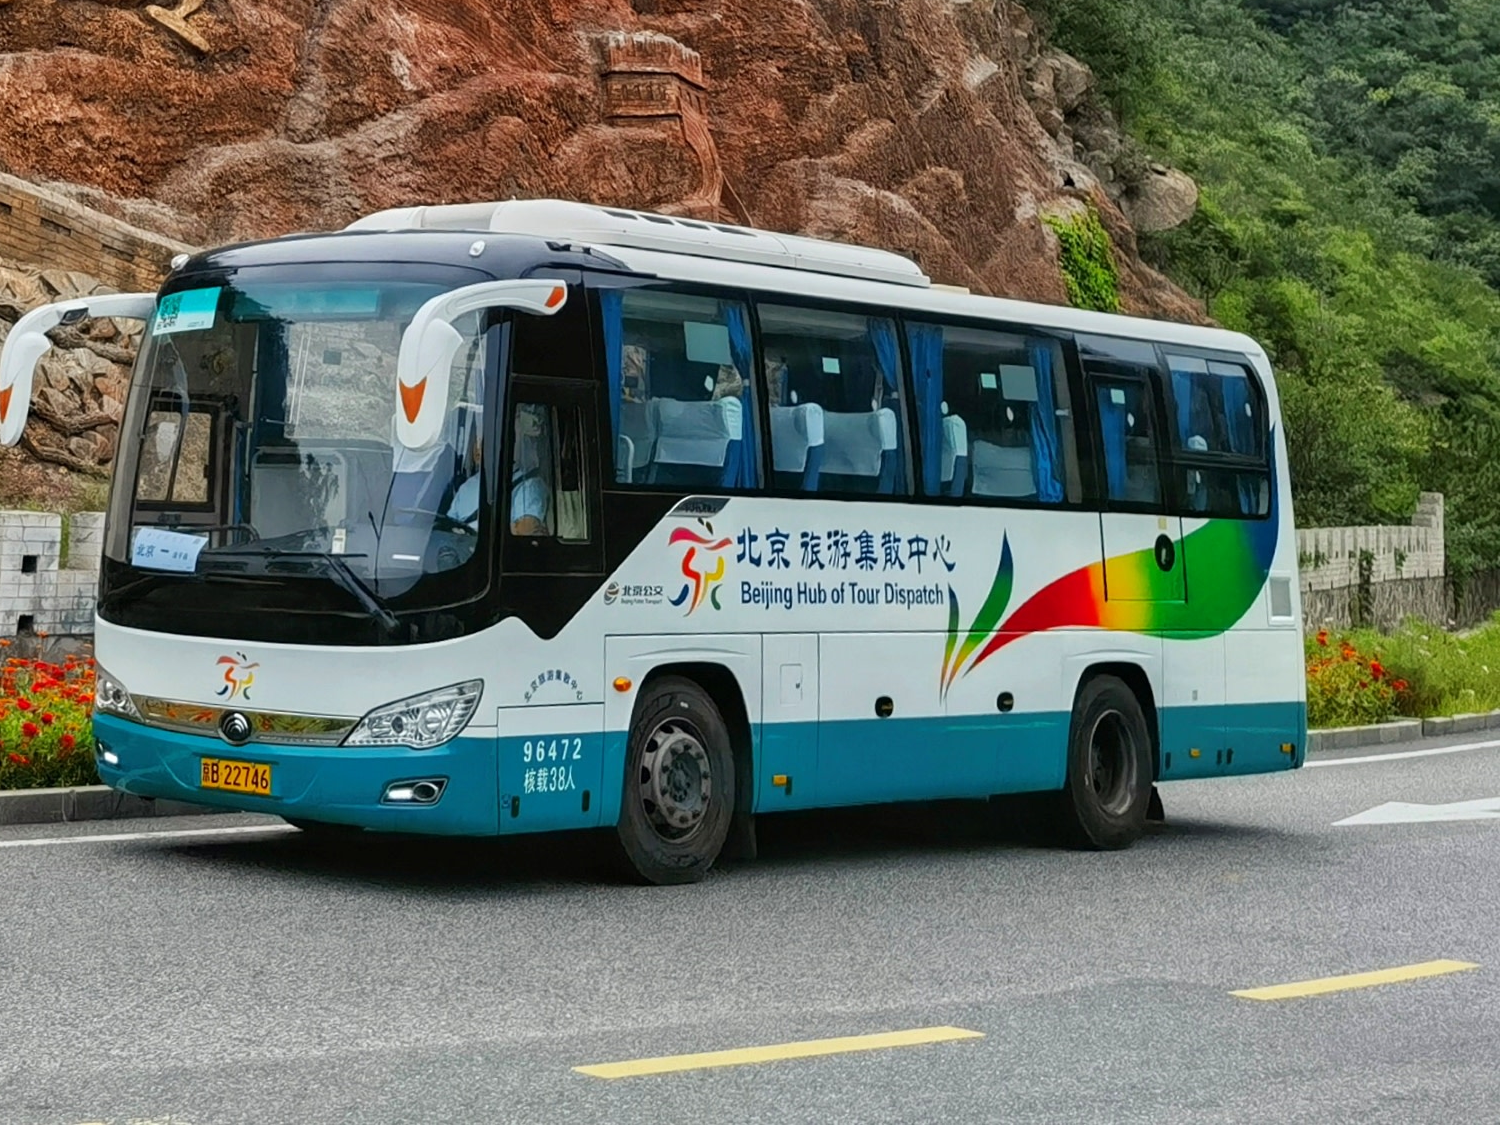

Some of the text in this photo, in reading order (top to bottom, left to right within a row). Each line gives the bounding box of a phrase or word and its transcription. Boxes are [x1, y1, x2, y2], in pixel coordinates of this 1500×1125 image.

[736, 526, 957, 575] 北京旅游集散中心
[622, 584, 664, 596] 北京公交
[740, 581, 944, 610] Beijing Hub of Tour Dispatch
[523, 737, 582, 763] 96472
[524, 765, 576, 794] 核载38人
